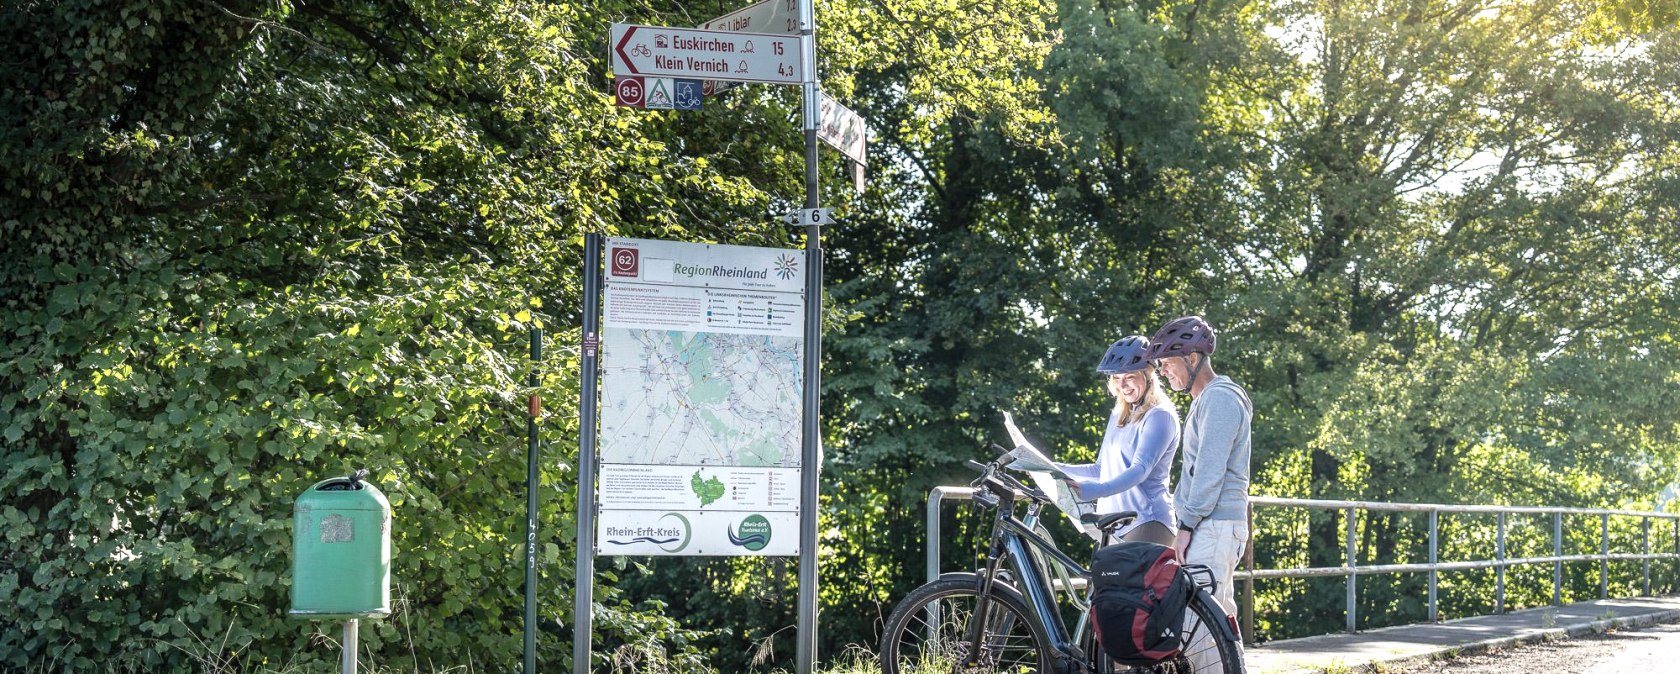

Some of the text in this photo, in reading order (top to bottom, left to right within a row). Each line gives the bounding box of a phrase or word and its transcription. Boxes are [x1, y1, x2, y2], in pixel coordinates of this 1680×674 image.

[728, 16, 751, 31] Liblar
[673, 35, 784, 56] Euskirchen 15
[655, 55, 683, 70] Klein
[687, 57, 728, 73] Vernich
[622, 86, 639, 97] 85
[811, 209, 820, 223] 6
[618, 255, 632, 265] 62
[674, 263, 768, 280] RegionRheinland
[606, 526, 680, 537] Rhein-Erft-Kreis
[528, 518, 536, 569] 4059
